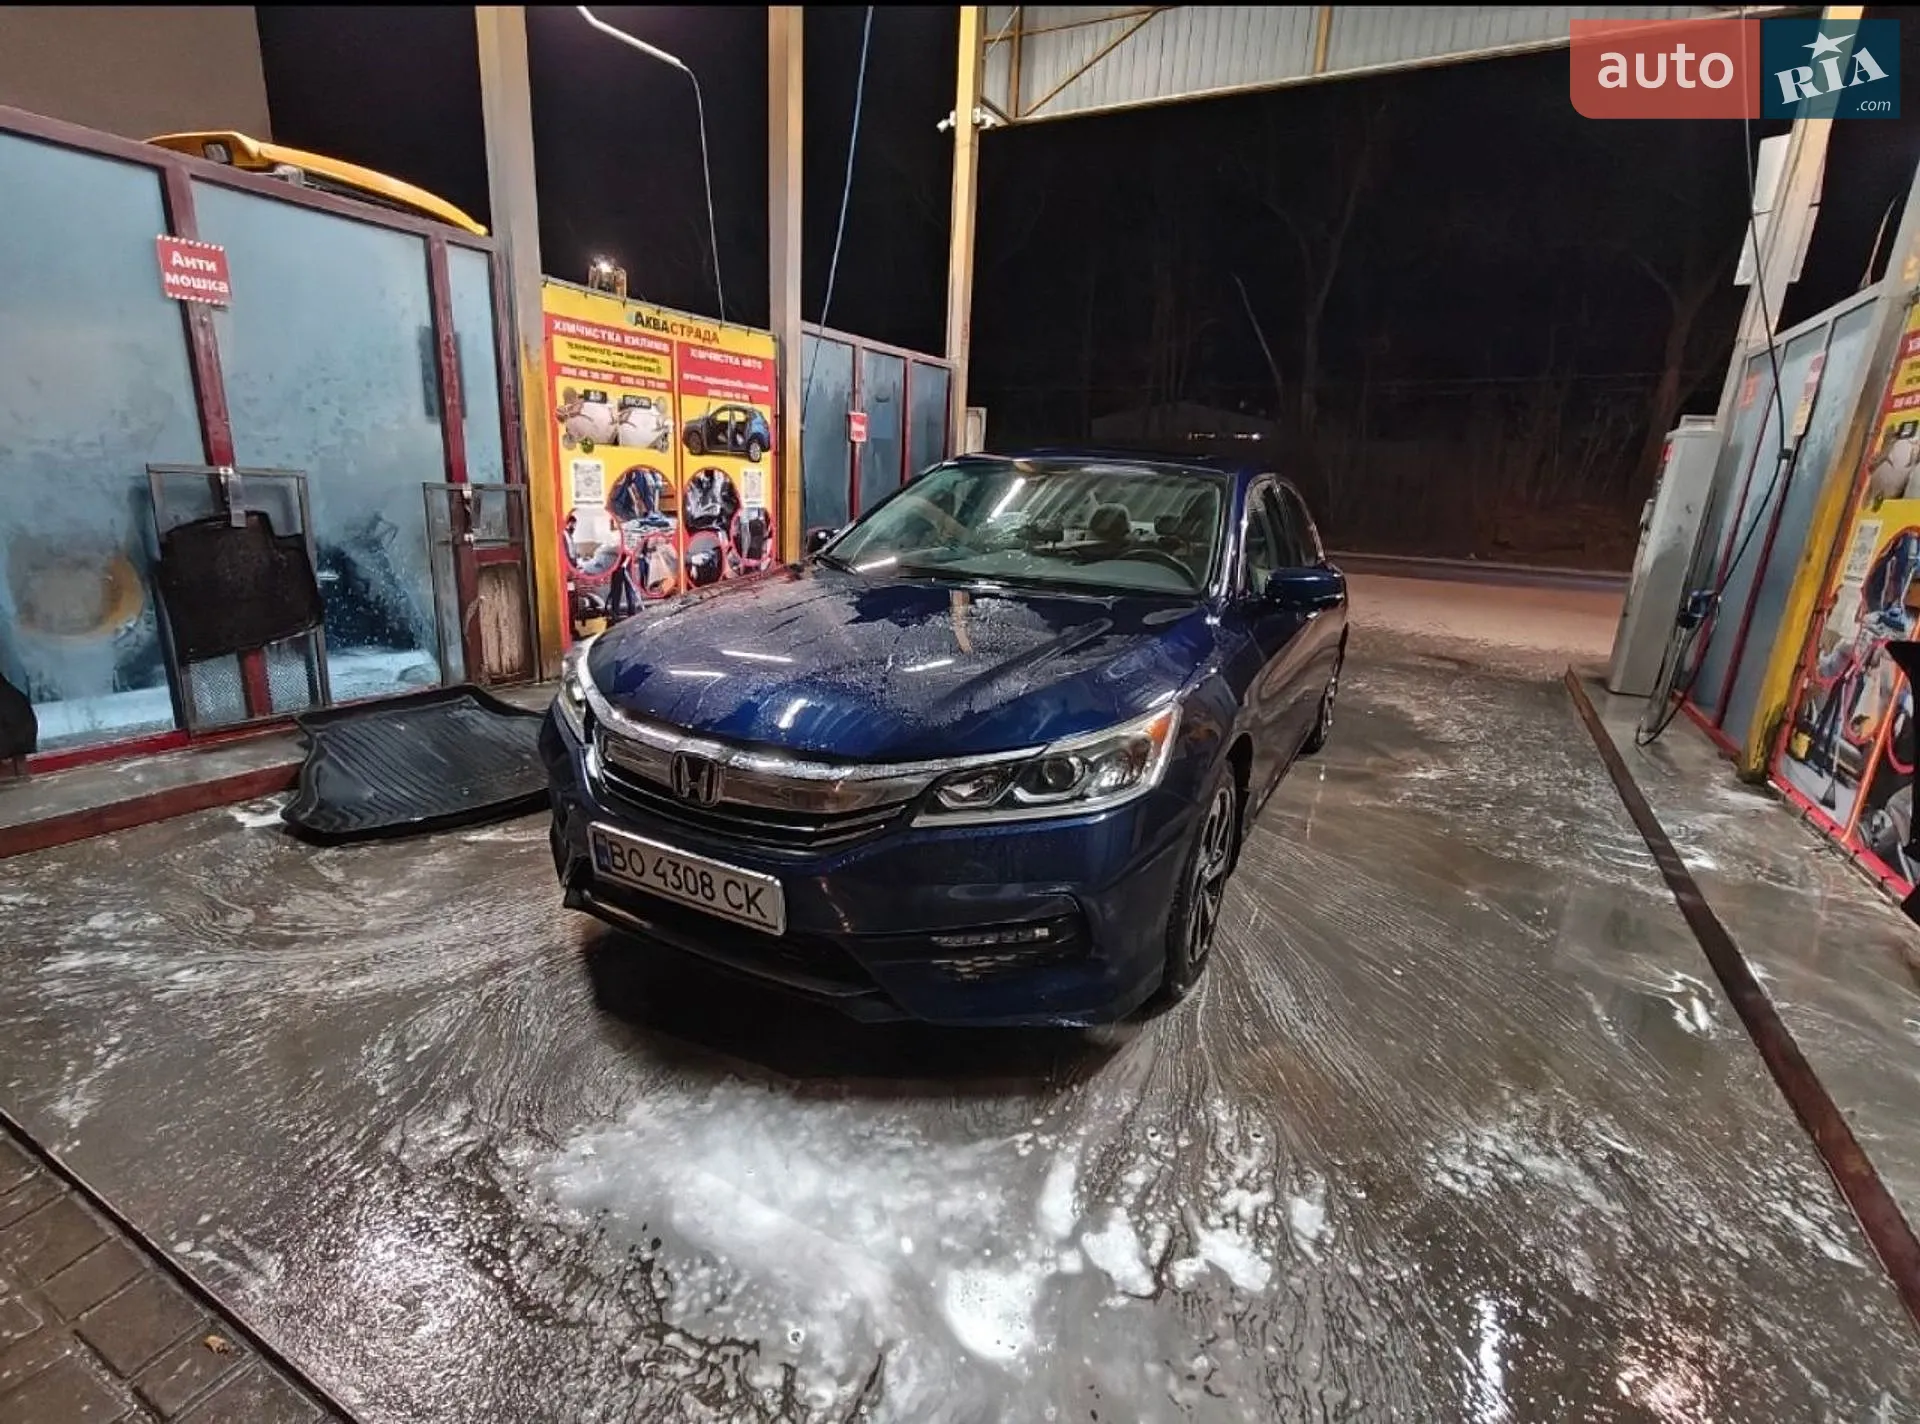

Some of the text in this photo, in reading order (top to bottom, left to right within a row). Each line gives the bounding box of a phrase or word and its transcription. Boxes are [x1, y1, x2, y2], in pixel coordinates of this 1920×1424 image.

[171, 250, 217, 273] Анти
[164, 272, 229, 293] мошка
[609, 841, 645, 877] BO
[653, 856, 716, 901] 4308
[724, 880, 767, 918] CK
